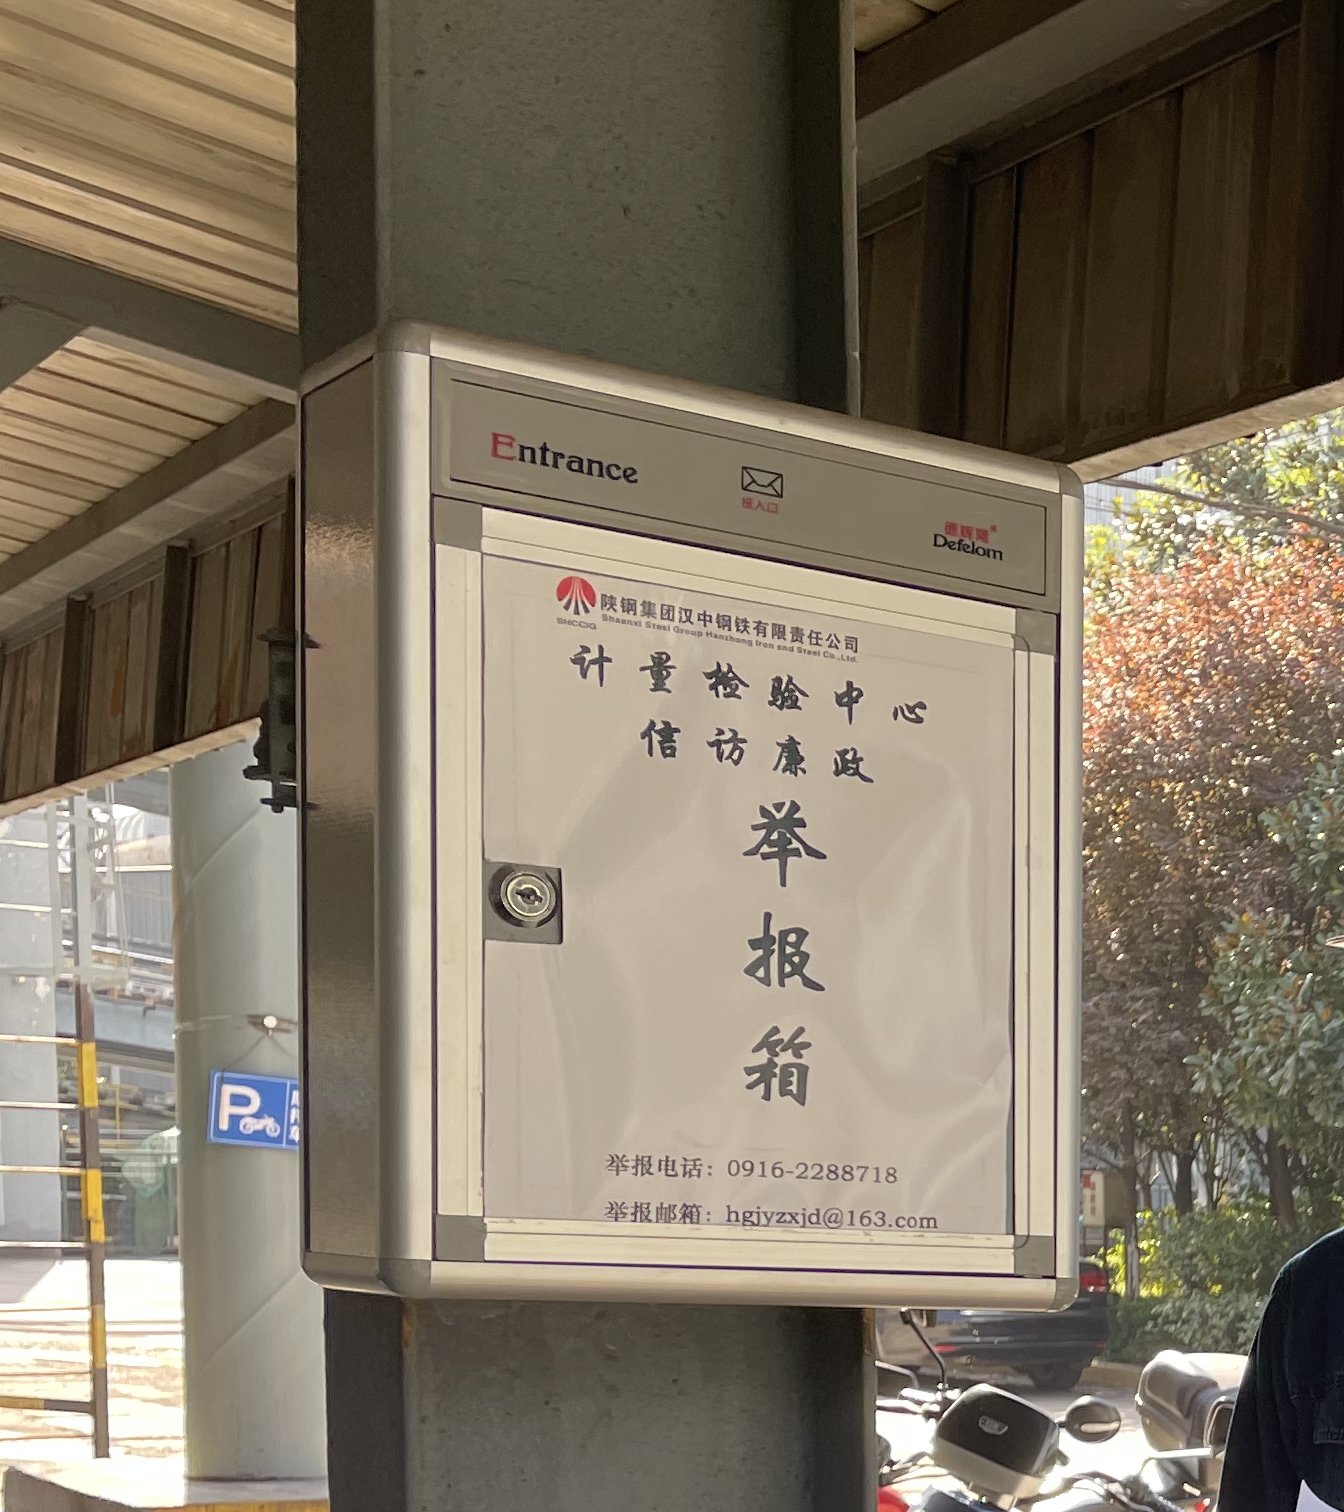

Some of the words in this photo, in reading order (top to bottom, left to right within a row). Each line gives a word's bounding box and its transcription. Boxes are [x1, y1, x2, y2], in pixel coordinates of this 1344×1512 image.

[490, 431, 639, 484] Entrance
[933, 533, 1003, 561] Defelom
[600, 592, 860, 654] 陕钢集团汉中钢铁有限责任公司
[673, 625, 703, 638] Group
[705, 630, 753, 647] Hanzhong
[755, 639, 775, 650] Iron
[777, 644, 795, 653] and
[797, 646, 821, 657] Steel
[569, 644, 928, 725] 计量检验中心
[640, 719, 874, 783] 信访廉政
[743, 799, 827, 1107] 举报箱
[218, 1083, 261, 1132] P
